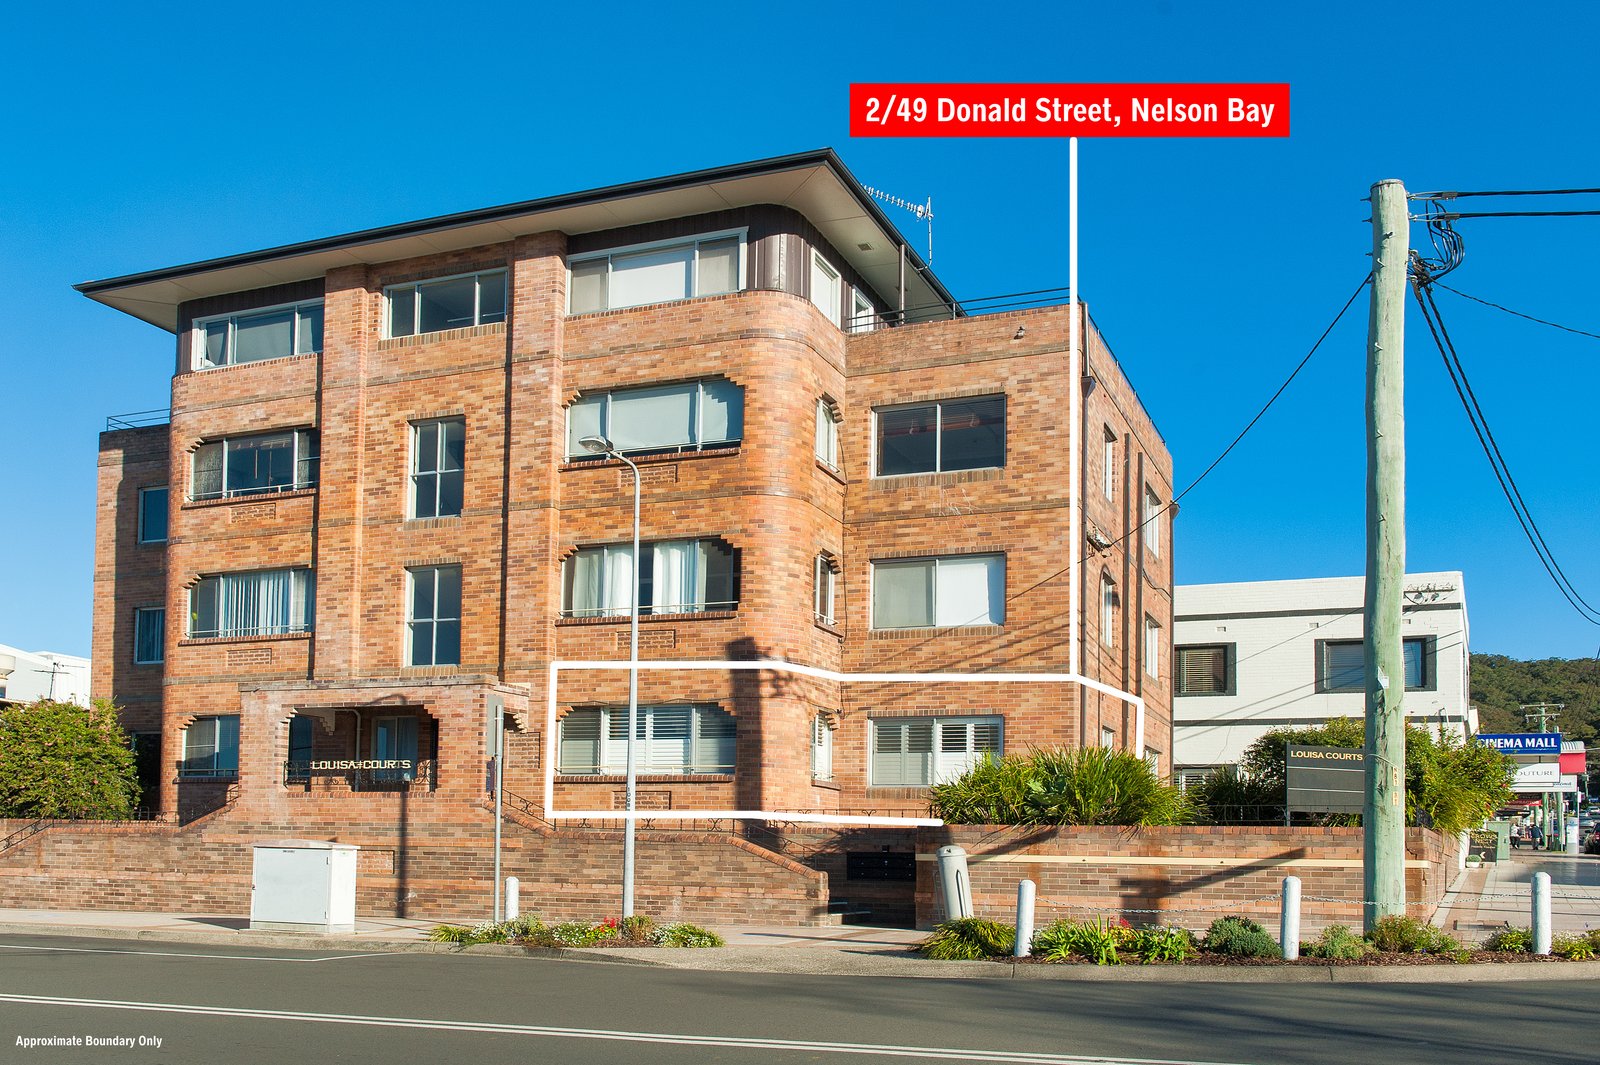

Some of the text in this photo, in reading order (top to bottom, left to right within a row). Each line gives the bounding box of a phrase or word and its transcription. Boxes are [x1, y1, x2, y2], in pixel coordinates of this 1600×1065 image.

[1525, 737, 1558, 748] MALL
[1291, 751, 1363, 761] LOUISA COURTS
